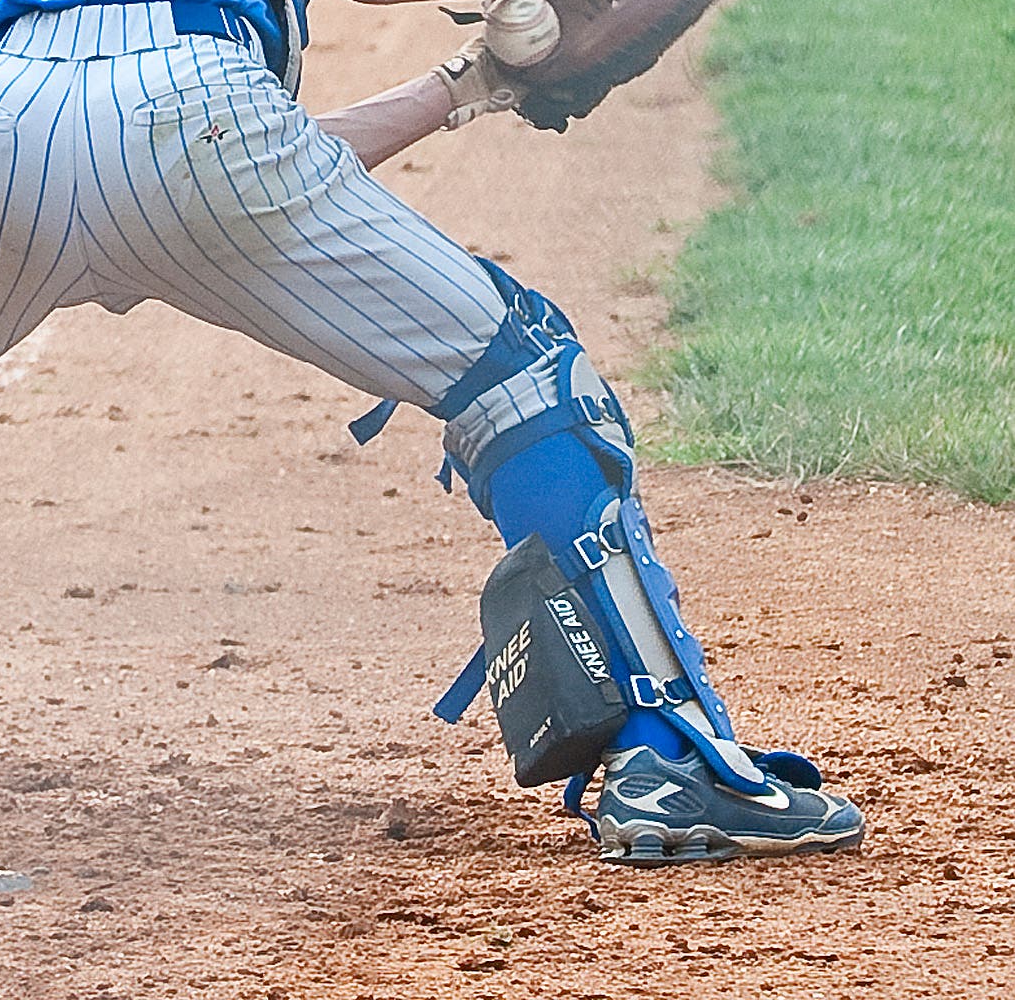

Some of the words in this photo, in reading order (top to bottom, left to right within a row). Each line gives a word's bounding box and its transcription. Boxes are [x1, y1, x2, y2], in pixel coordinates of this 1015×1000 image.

[549, 598, 583, 628] AID
[485, 619, 532, 686] KNEE
[569, 630, 612, 680] KNEE
